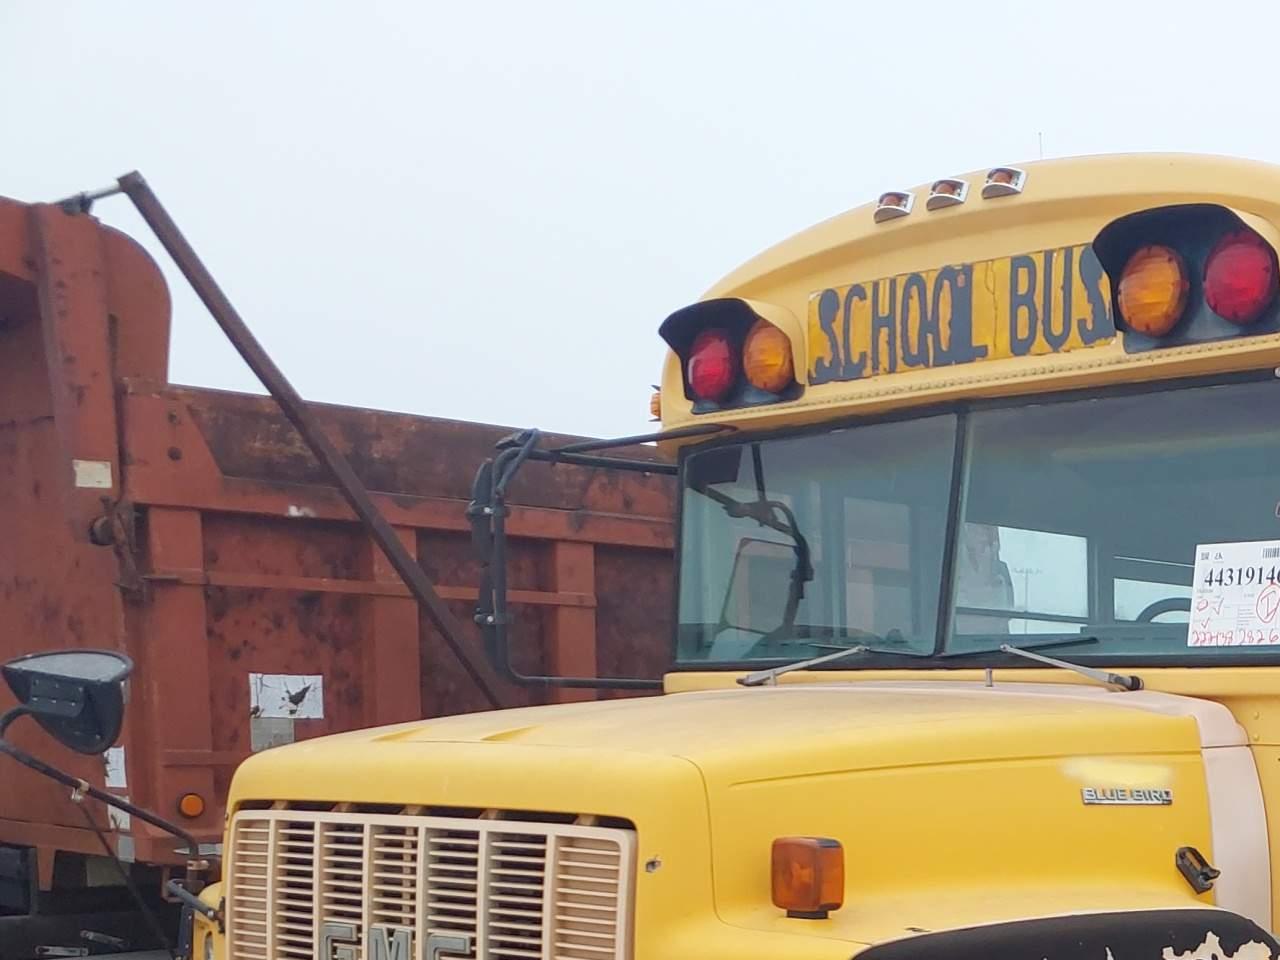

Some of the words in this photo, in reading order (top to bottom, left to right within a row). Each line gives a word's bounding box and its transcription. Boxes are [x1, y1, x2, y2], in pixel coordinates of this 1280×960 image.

[808, 263, 988, 386] SCHOOL
[1010, 243, 1117, 356] BUS
[1081, 787, 1128, 801] BLUE
[1131, 788, 1173, 802] BIRD
